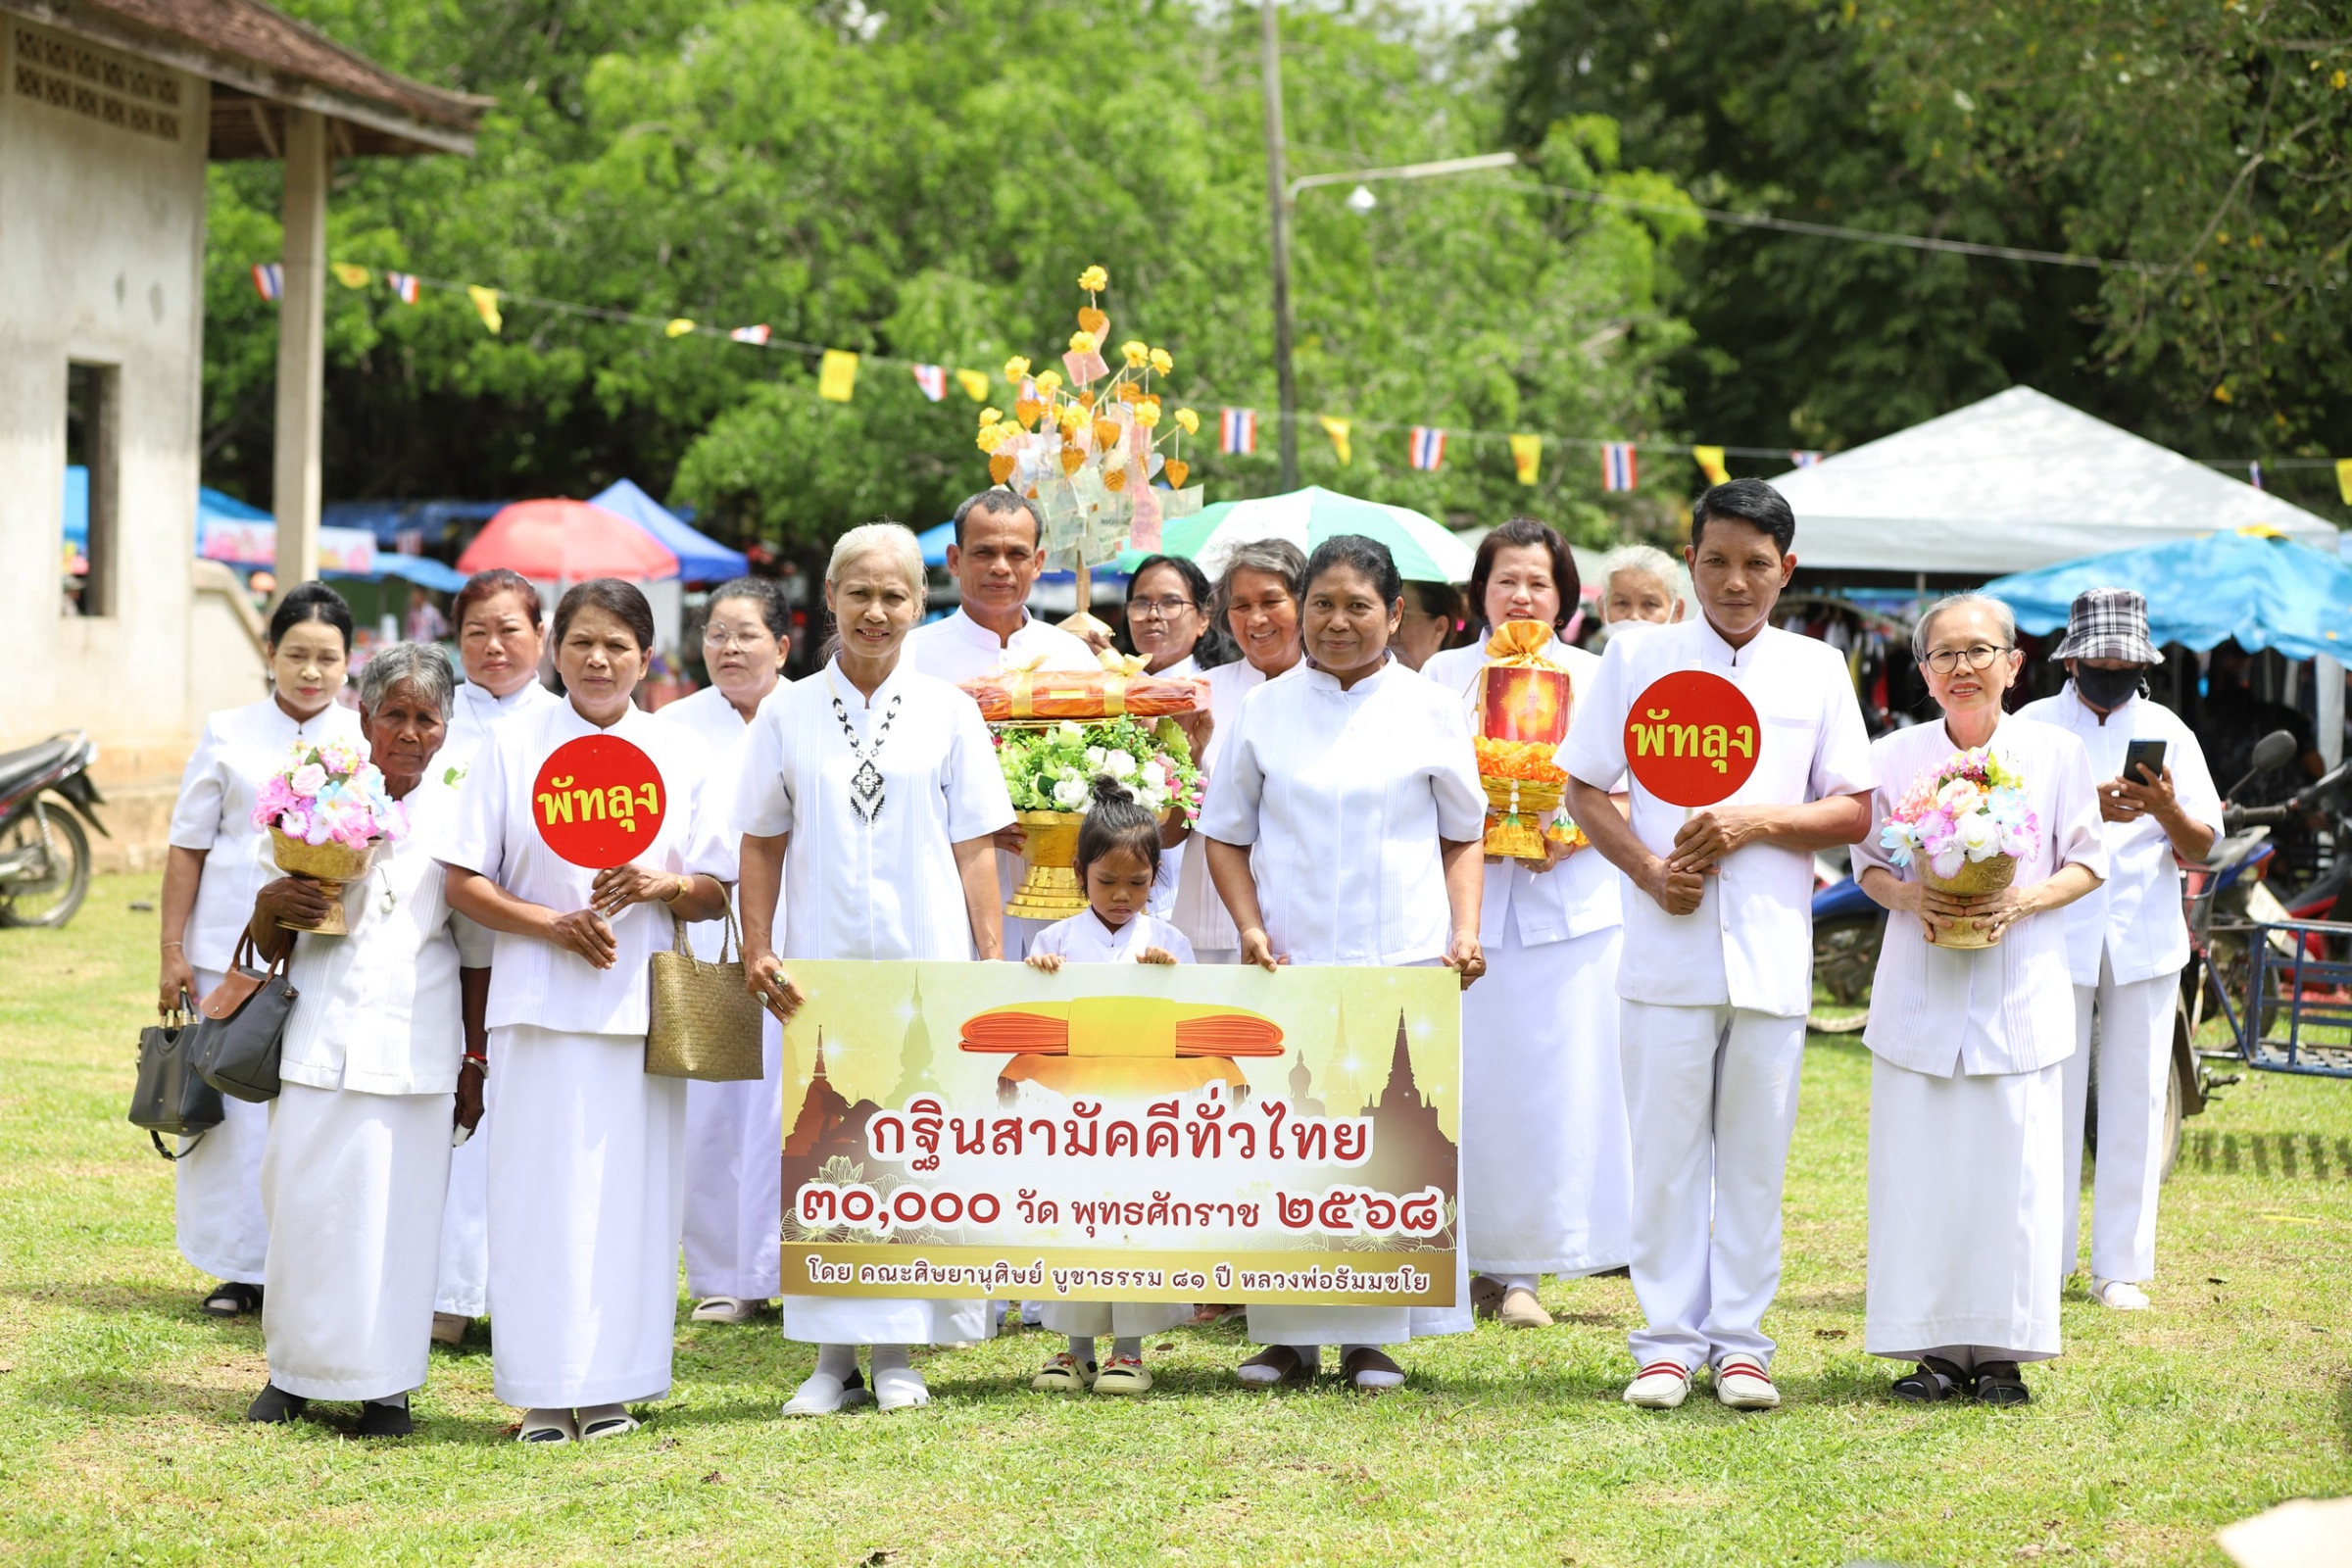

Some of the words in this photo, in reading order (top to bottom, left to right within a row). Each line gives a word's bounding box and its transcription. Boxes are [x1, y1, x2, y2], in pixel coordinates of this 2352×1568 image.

[1630, 709, 1753, 773] พัทลุง
[537, 775, 659, 833] พัทลุง
[873, 1086, 1366, 1171] กฐินสามัคคีทั่วไทย
[803, 1190, 1001, 1230] ๓๐,๐๐๐
[1016, 1188, 1058, 1224] วัด
[1071, 1192, 1259, 1238] พุทธศักราช
[1277, 1191, 1438, 1231] ๒๕๖๘
[808, 1257, 851, 1281] โดย
[861, 1260, 1042, 1292] คณะศิษยานุศิษย์
[1054, 1268, 1162, 1293] บูชาธรรม
[1172, 1274, 1205, 1289] ๘๑
[1215, 1265, 1231, 1288] ปี
[1242, 1266, 1428, 1292] หลวงพ่อธัมมชโย
